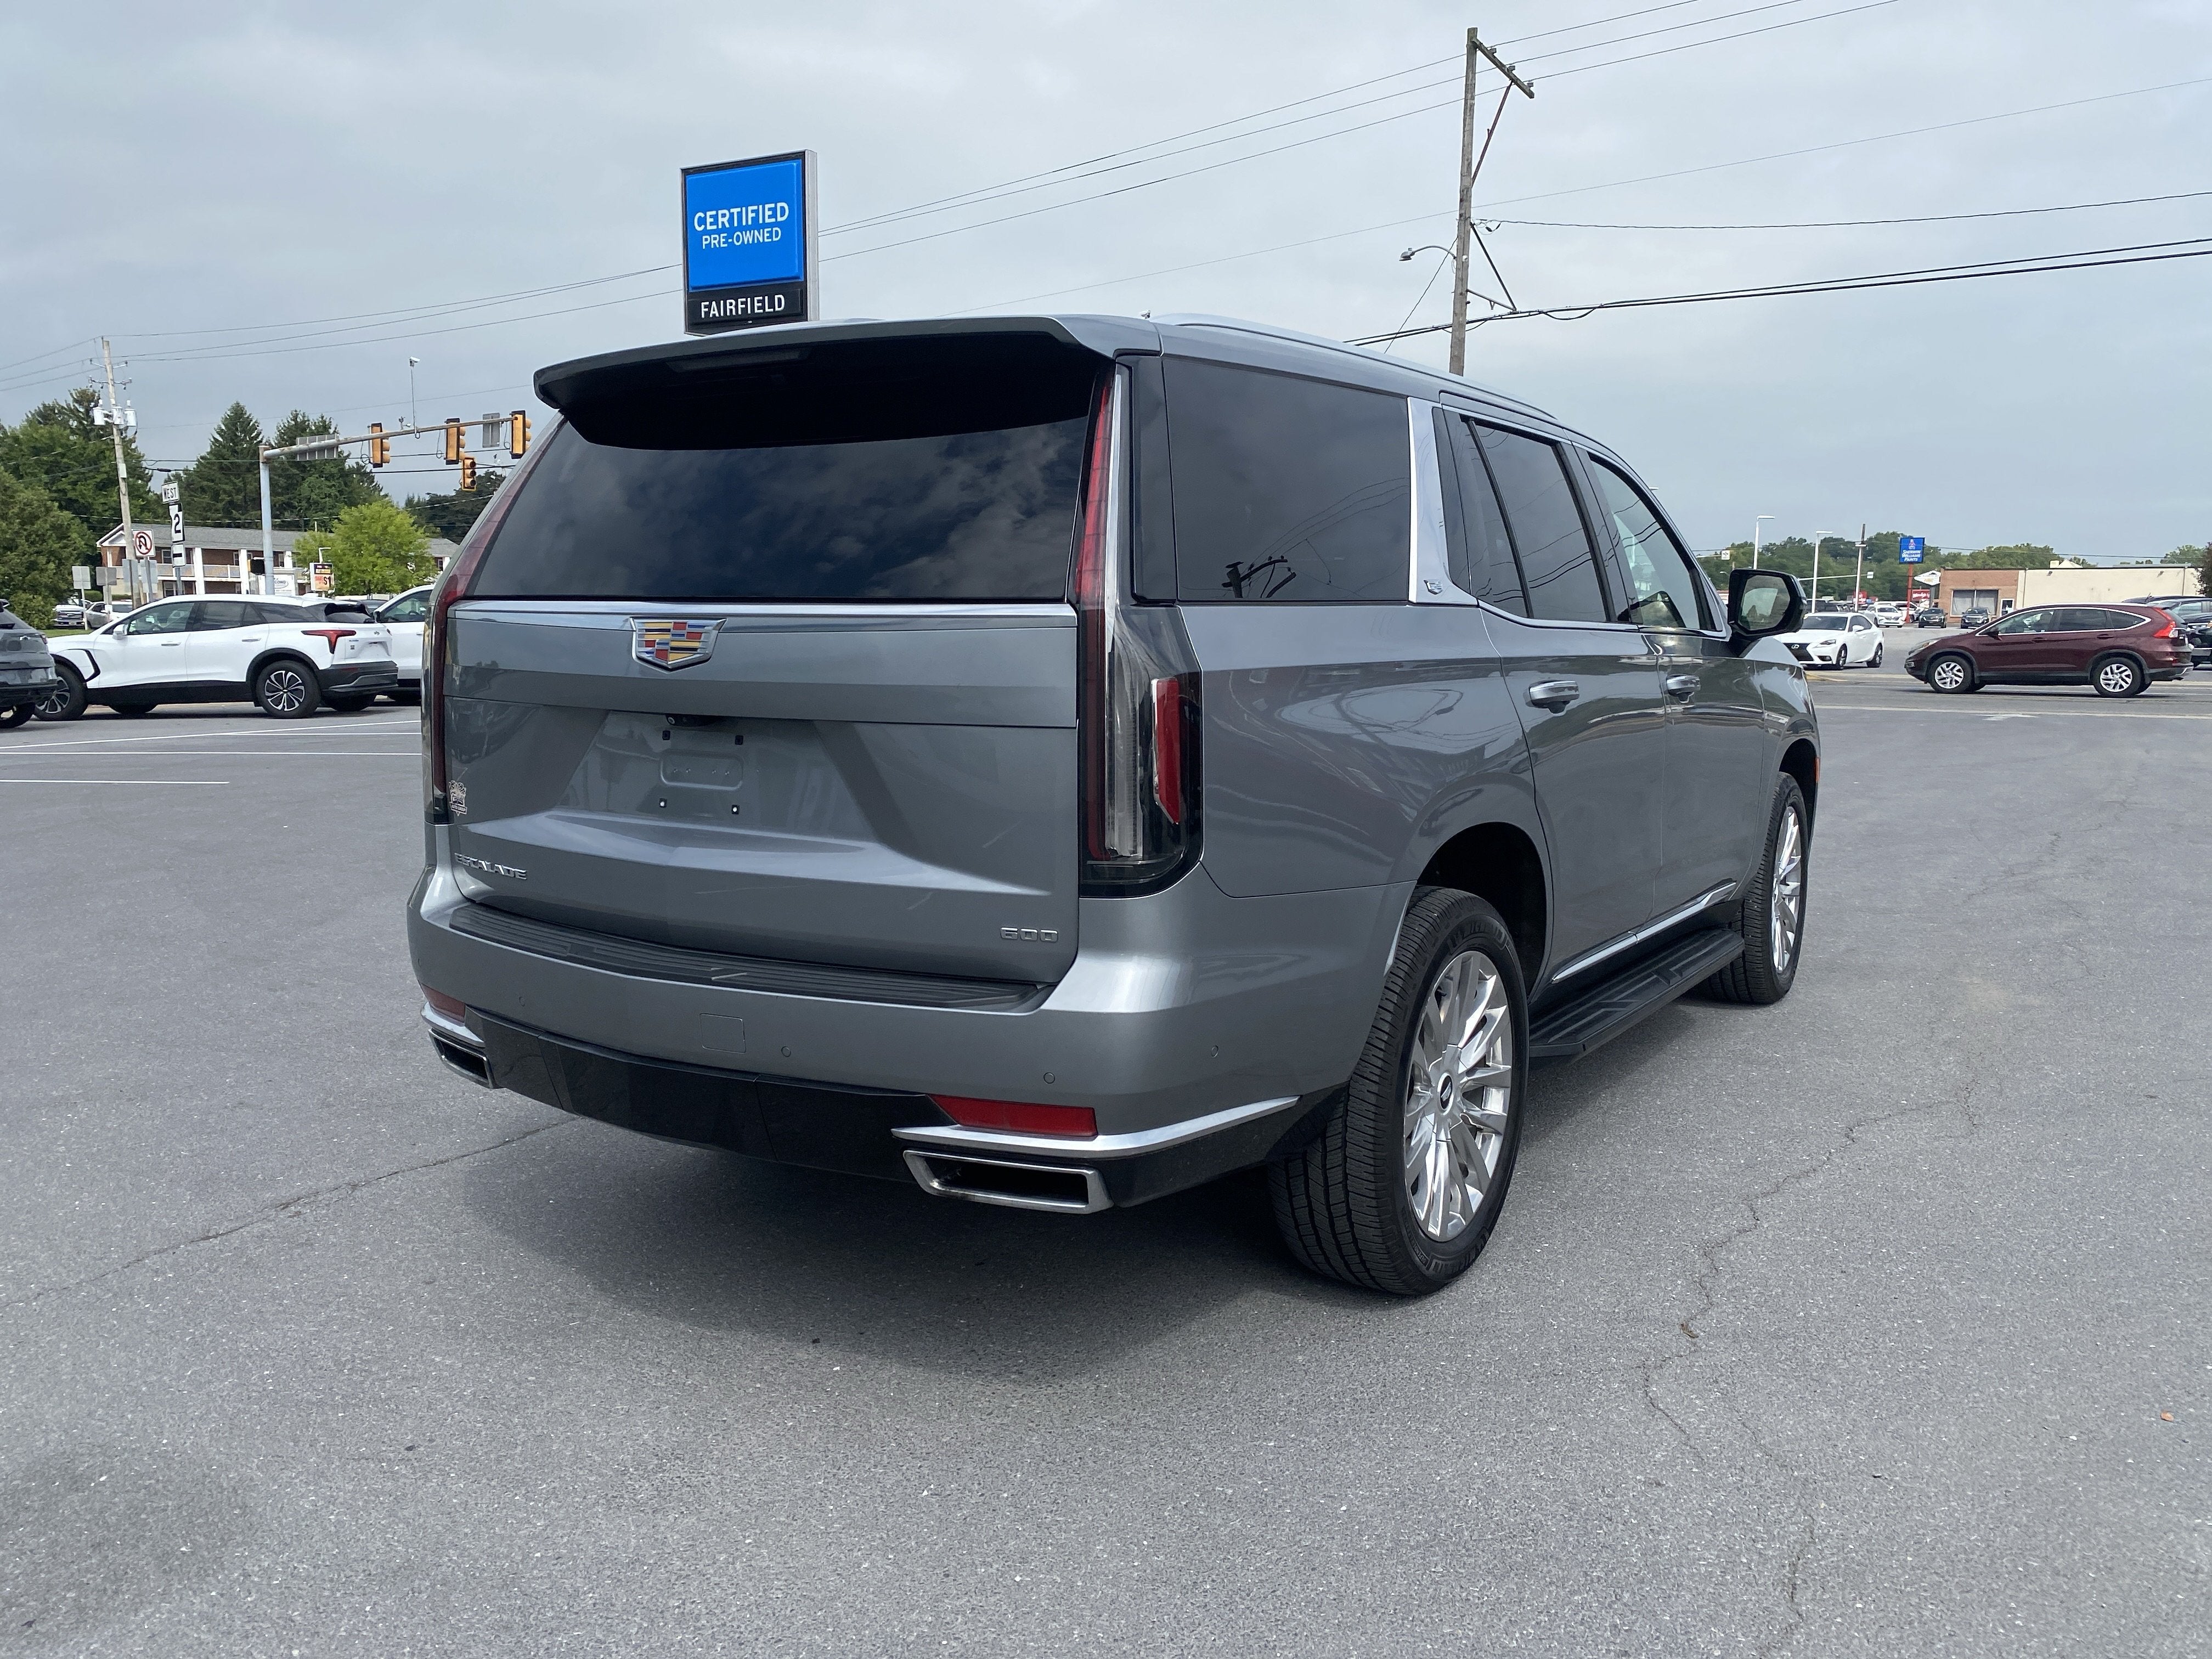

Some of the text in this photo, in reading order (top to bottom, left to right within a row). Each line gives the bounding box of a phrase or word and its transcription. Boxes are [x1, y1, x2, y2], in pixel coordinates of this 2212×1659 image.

[694, 202, 789, 232] CERTIFIED
[702, 227, 782, 249] PRE-OWNED
[701, 294, 785, 318] FAIRFIELD
[174, 514, 182, 533] 2
[454, 853, 527, 879] ESCALADE
[1001, 927, 1058, 943] 600
